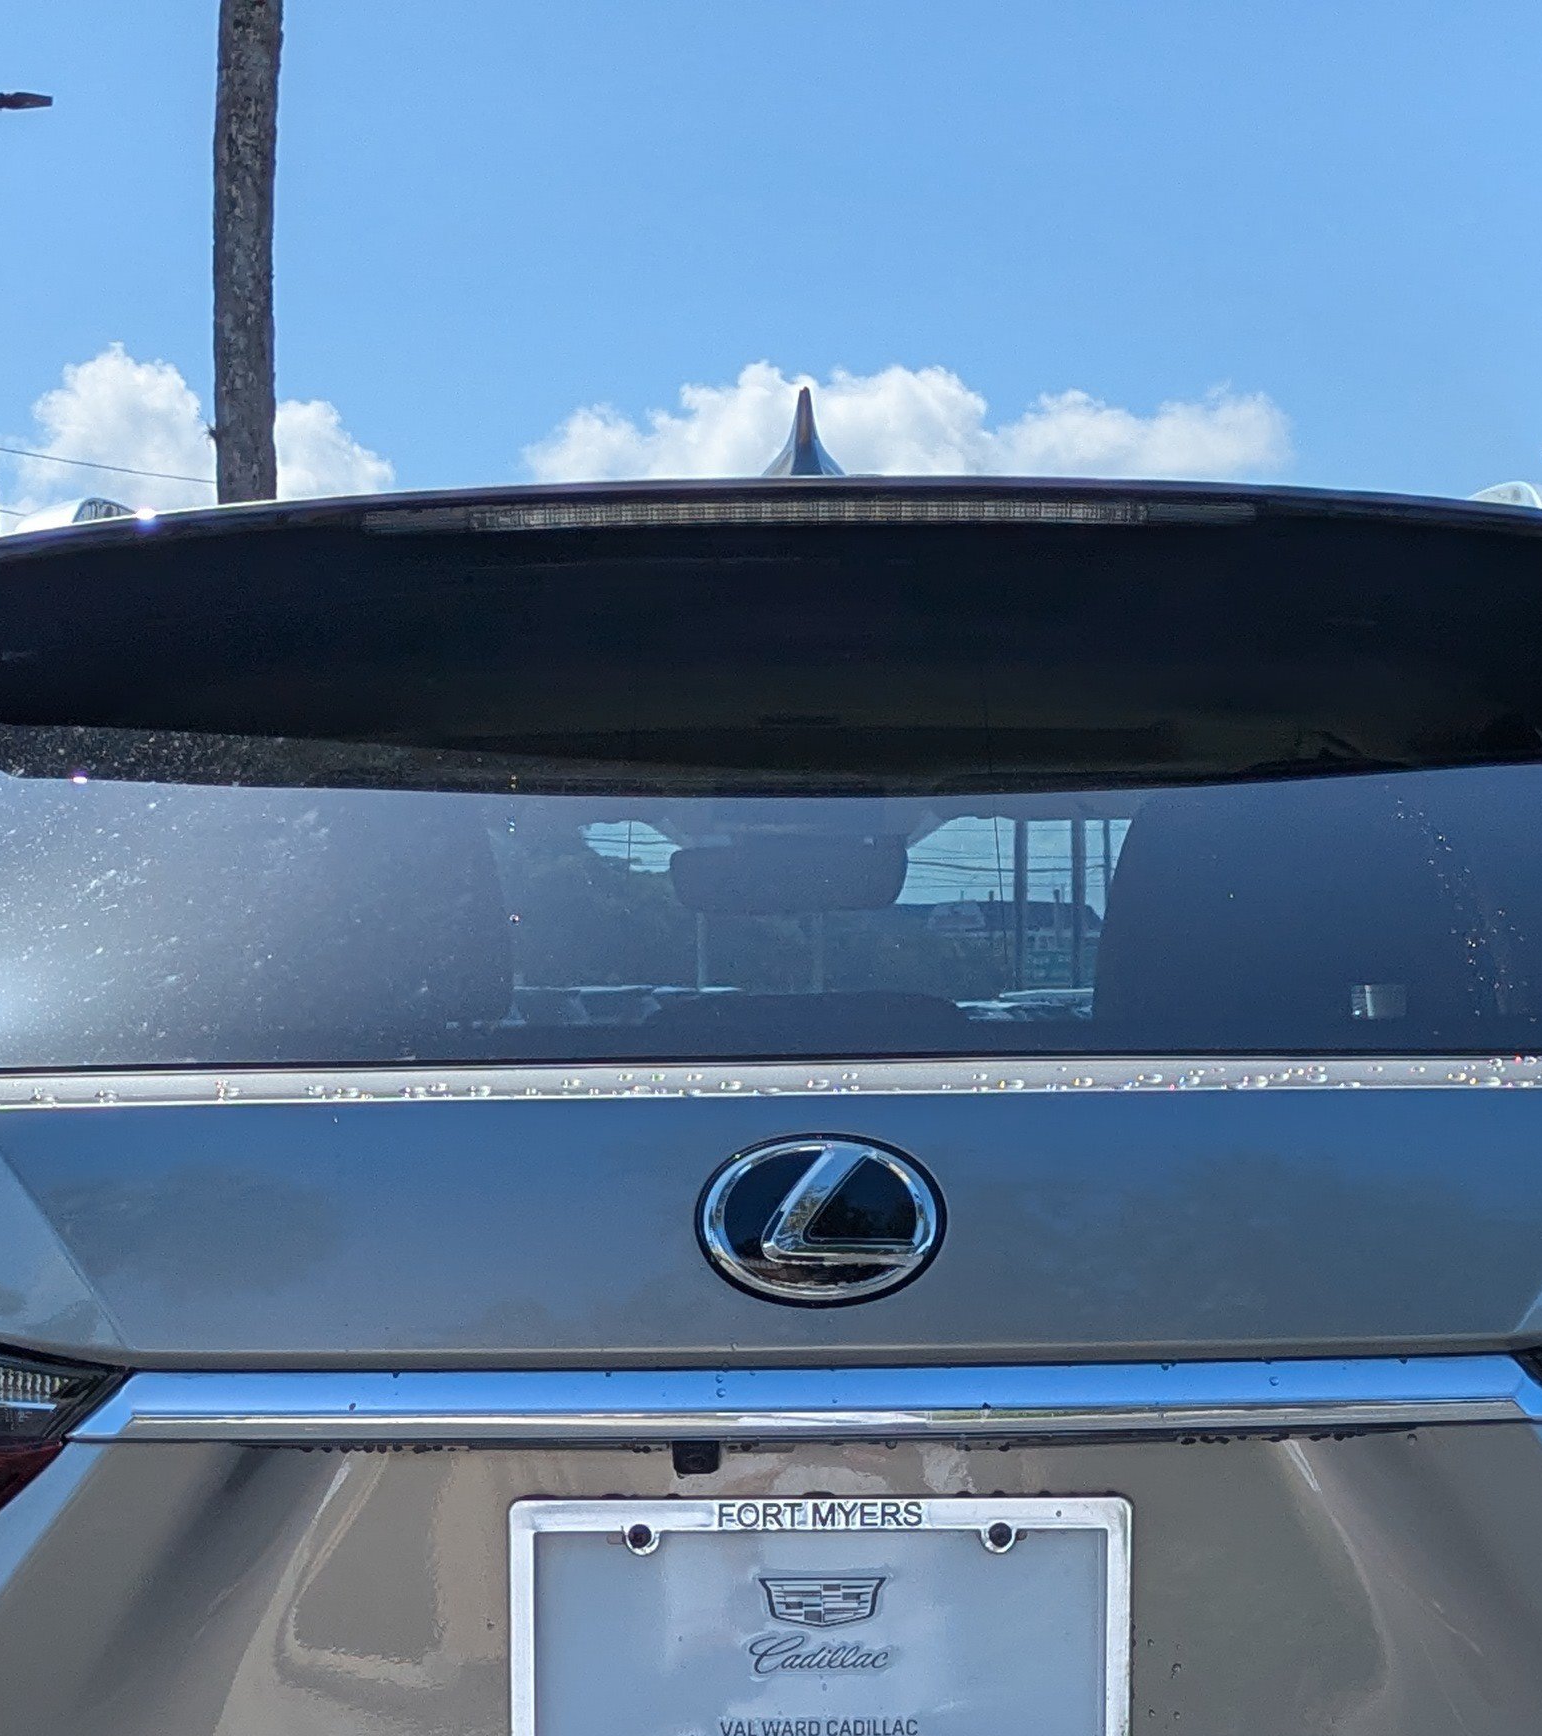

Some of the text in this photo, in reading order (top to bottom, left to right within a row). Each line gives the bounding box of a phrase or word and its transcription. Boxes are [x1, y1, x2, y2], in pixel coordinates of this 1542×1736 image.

[717, 1501, 923, 1528] FORT MYERS
[748, 1635, 890, 1675] Cadillac
[825, 1718, 919, 1736] CADILLAC
